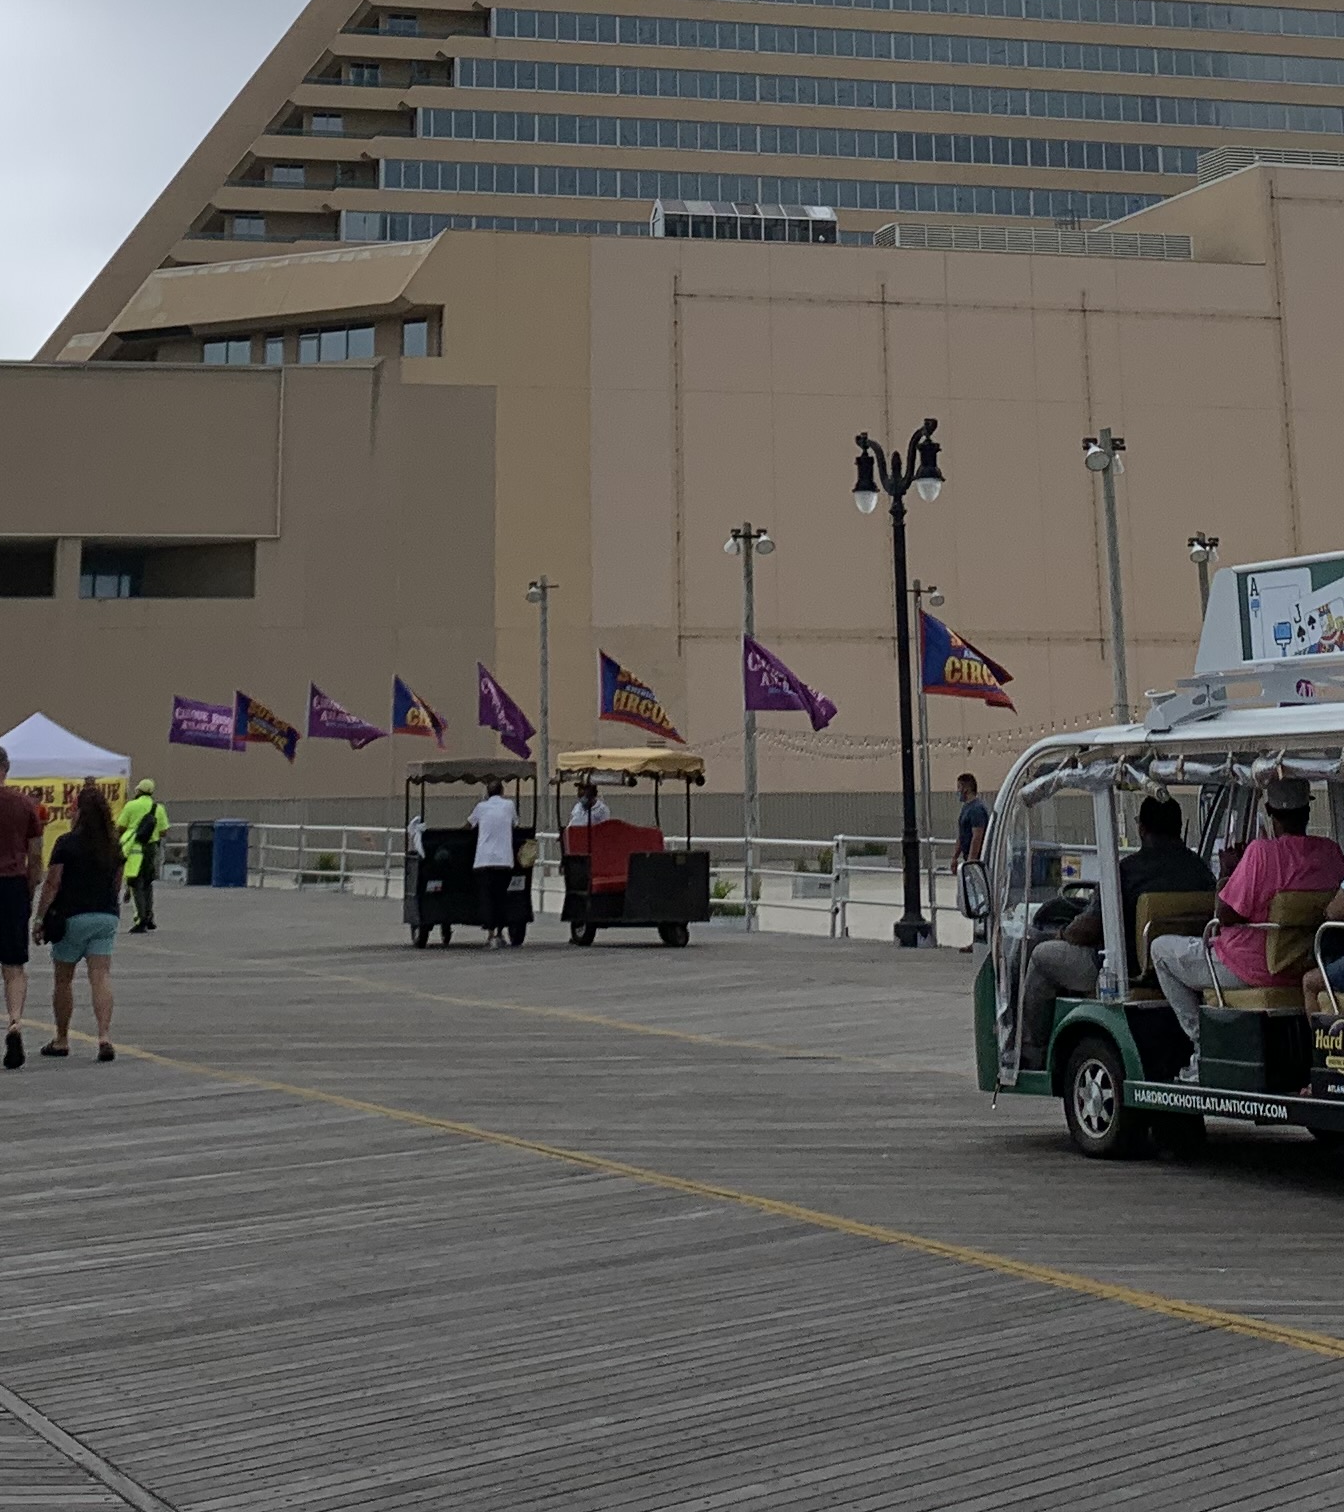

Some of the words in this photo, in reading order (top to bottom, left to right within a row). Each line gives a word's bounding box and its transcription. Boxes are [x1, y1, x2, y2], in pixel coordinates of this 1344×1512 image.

[1250, 577, 1260, 597] A
[1294, 603, 1302, 624] J
[945, 656, 997, 686] CIRC
[1315, 1028, 1343, 1049] Hard
[1134, 1089, 1288, 1120] HARDROCKHOTELATLANTICCITY.COM
